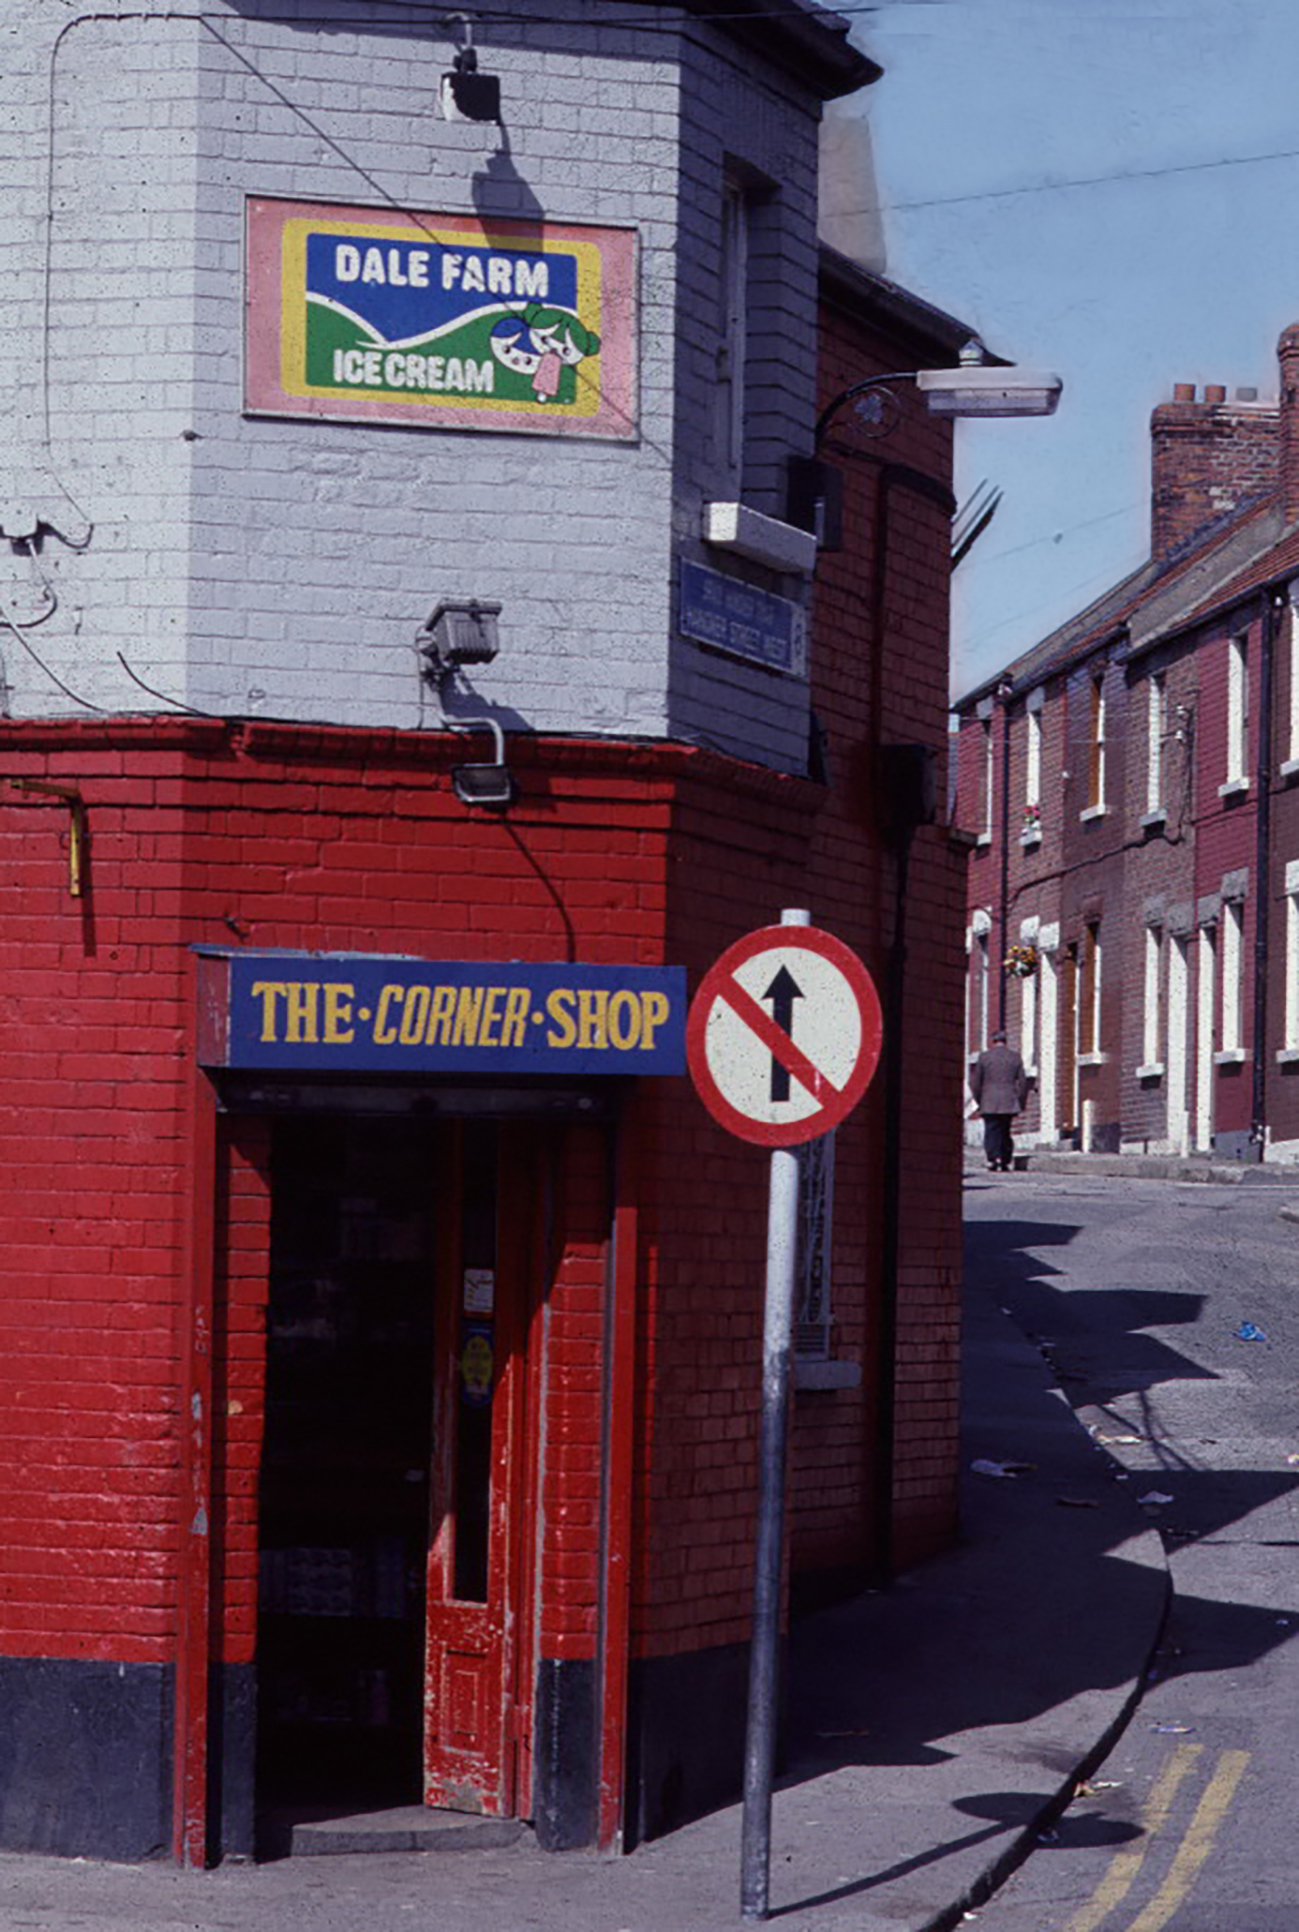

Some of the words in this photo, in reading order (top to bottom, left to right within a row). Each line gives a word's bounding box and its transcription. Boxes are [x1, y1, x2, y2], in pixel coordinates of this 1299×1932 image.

[335, 243, 430, 288] DALE
[441, 253, 550, 298] FARM
[333, 348, 383, 384] ICE
[384, 351, 495, 393] CREAM
[252, 981, 356, 1043] THE
[372, 984, 532, 1047] CORNER
[546, 989, 670, 1050] SHOP
